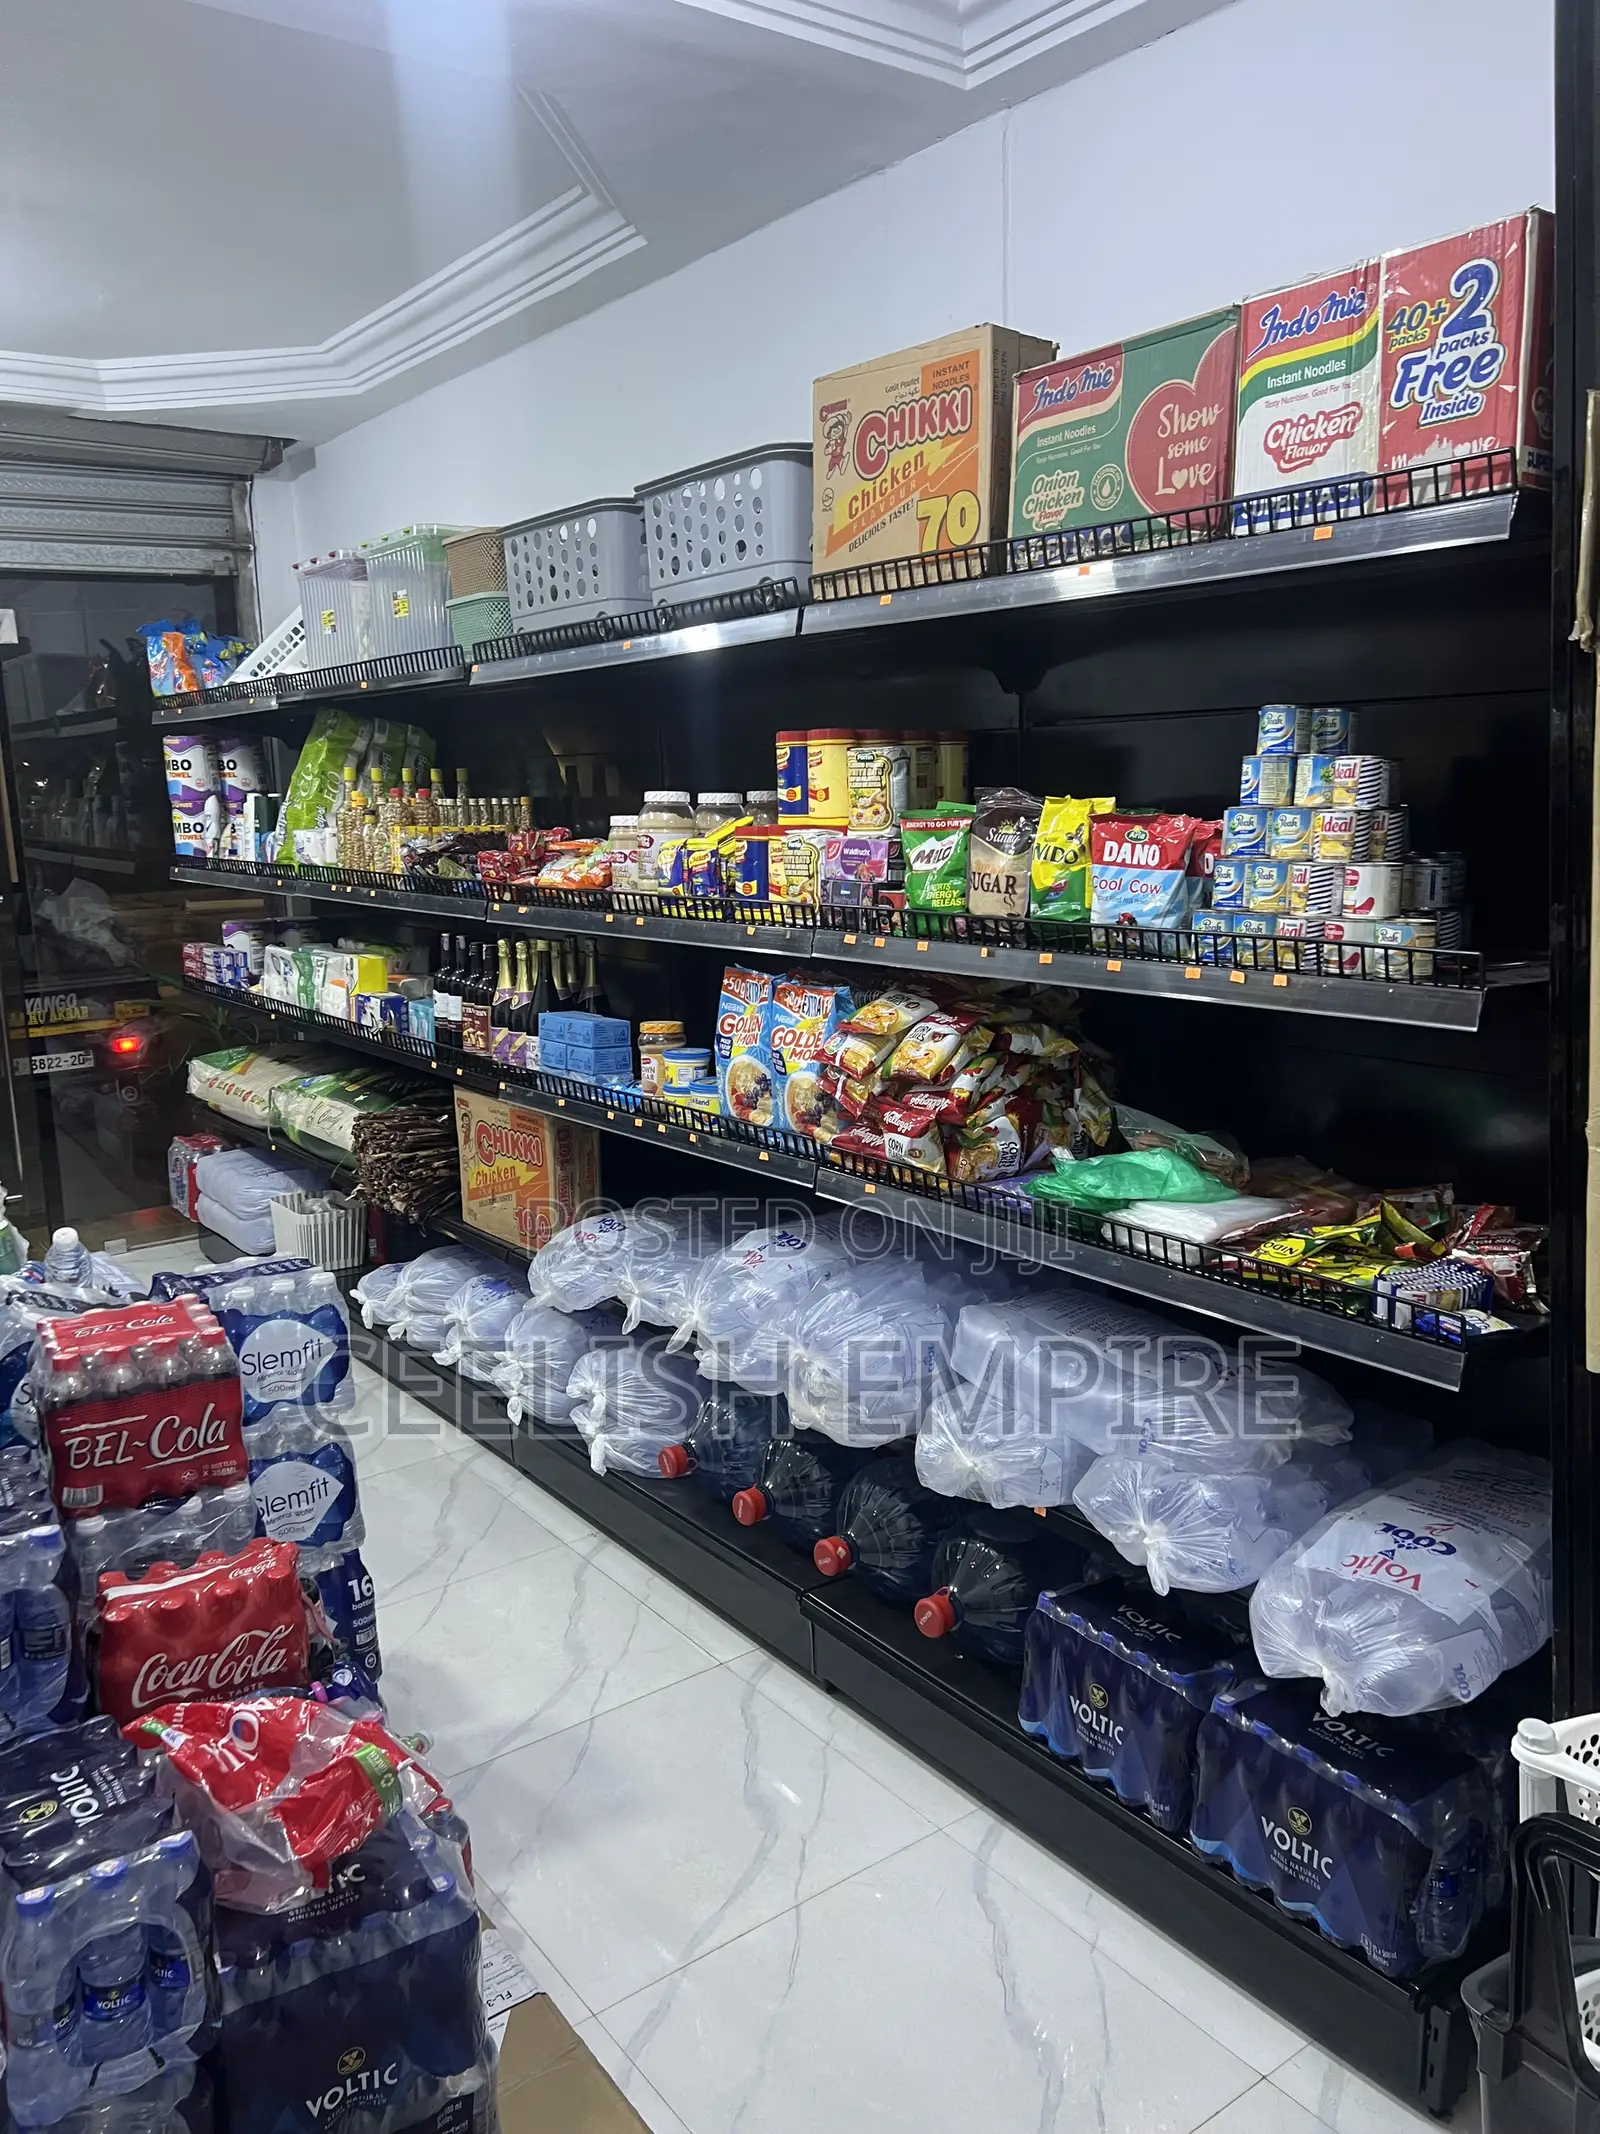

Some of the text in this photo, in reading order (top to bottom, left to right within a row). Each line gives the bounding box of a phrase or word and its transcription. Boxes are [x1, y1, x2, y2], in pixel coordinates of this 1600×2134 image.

[1389, 329, 1489, 358] packs packs
[932, 360, 970, 378] INSTANT
[1267, 359, 1347, 389] Instant Noodles
[1391, 344, 1504, 406] Free
[932, 374, 970, 391] NOODLES
[1157, 402, 1224, 438] Show
[1422, 395, 1481, 422] Inside
[854, 386, 972, 480] CHIKKI
[1037, 424, 1096, 447] Instant Noodles
[1266, 404, 1359, 448] Chicken
[1168, 436, 1212, 459] some
[1284, 440, 1328, 461] Flavor
[848, 450, 924, 520] Chicken
[1033, 470, 1078, 496] Onion
[852, 482, 917, 533] FLAVOUR
[1024, 489, 1083, 514] Chicken
[849, 499, 914, 553] DELICIOUS TASTE!
[917, 490, 981, 554] 70
[1039, 508, 1064, 522] Flavor
[1129, 830, 1146, 840] Arla
[1321, 816, 1354, 833] Ideal
[913, 845, 953, 865] MILO
[1103, 841, 1160, 866] DANO
[1092, 875, 1163, 894] Cool Cow
[1279, 923, 1303, 938] deal
[772, 1027, 823, 1049] GOLDE
[789, 1047, 816, 1061] MOR
[883, 1109, 915, 1132] Kellogg's
[475, 1120, 543, 1167] CHIKKI
[888, 1137, 904, 1154] CORN
[1008, 1141, 1019, 1168] CORN
[476, 1166, 516, 1186] Chicken
[513, 1205, 551, 1243] 100
[1263, 1240, 1300, 1256] NIDO
[241, 1337, 324, 1377] Slemfit
[254, 1477, 330, 1518] Slemfit
[265, 1512, 293, 1526] Mineral
[1375, 1521, 1457, 1557] COOL
[1341, 1553, 1422, 1592] Voltic
[348, 1575, 374, 1601] 16
[1117, 1605, 1182, 1643] VOLTIC
[132, 1624, 295, 1709] Coca-Cola
[1069, 1695, 1124, 1746] VOLTIC
[1312, 1711, 1394, 1758] VOLTIC
[1260, 1815, 1334, 1880] VOLTIC
[1289, 1858, 1322, 1884] NATURAL
[1298, 1871, 1322, 1892] WATER
[1429, 1880, 1444, 1889] LTIC
[288, 1895, 360, 1923] MINERAL WATER
[316, 1890, 355, 1909] NATURAL
[96, 1994, 131, 2011] VOLTIC
[53, 2014, 73, 2031] VOL
[306, 2062, 400, 2119] VOLTIC
